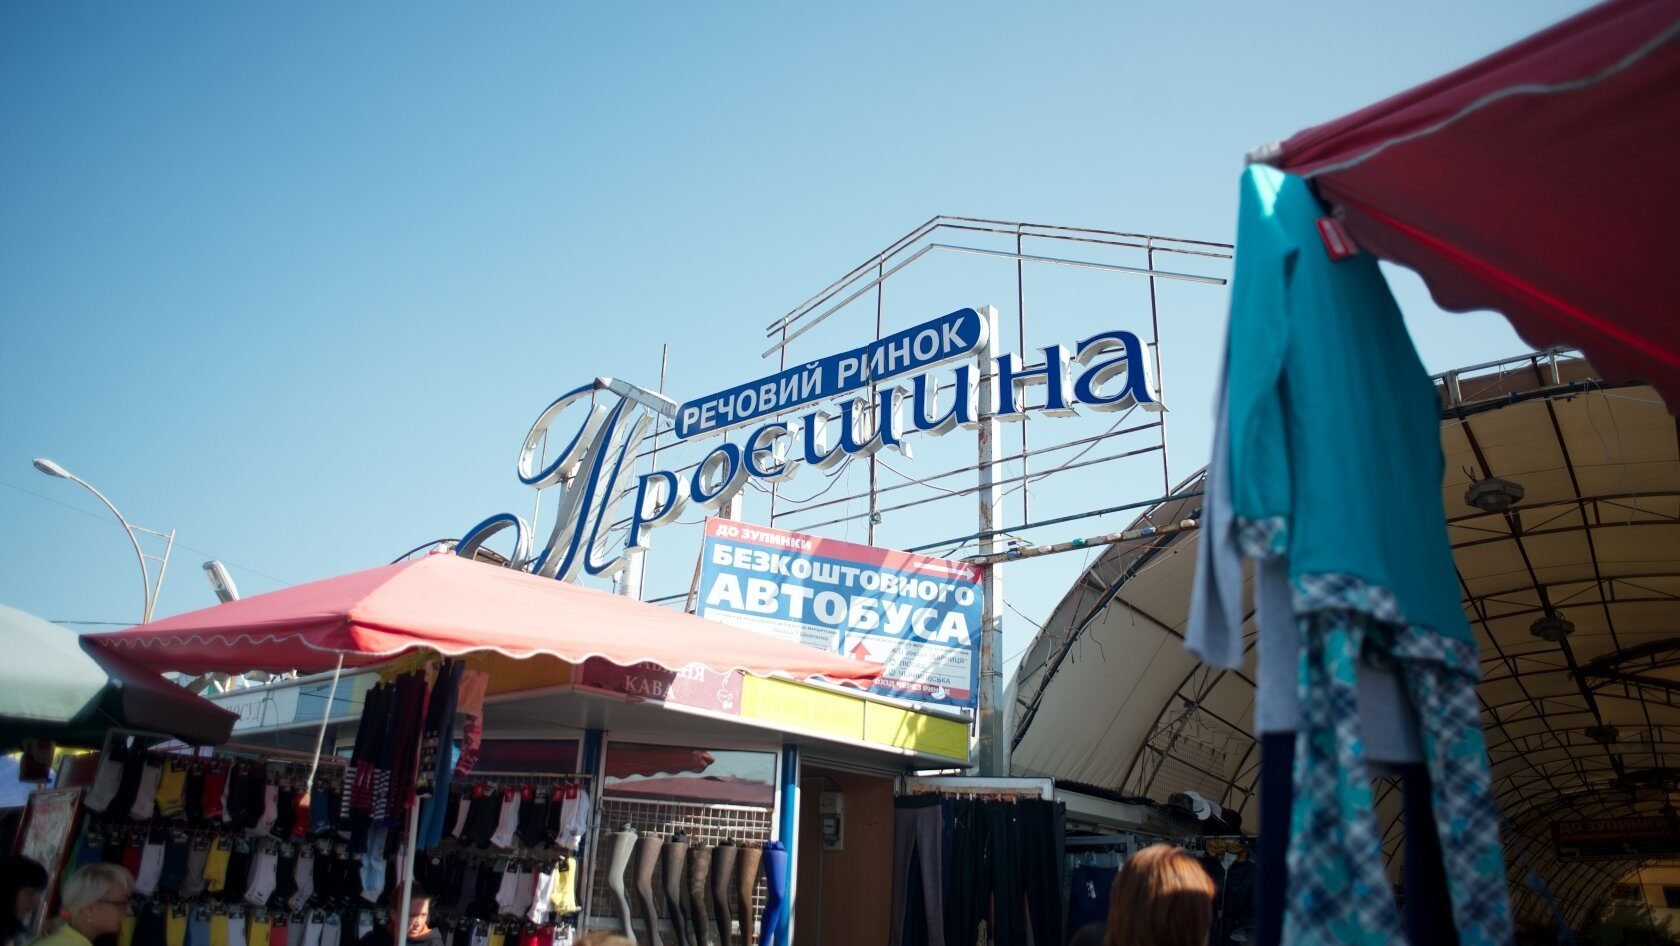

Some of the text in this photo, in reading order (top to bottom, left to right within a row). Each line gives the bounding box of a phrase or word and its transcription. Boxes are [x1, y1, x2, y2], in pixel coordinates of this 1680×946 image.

[681, 316, 969, 435] РЕЧОВИЙ РИНОК
[716, 524, 812, 551] ДО ЗУПИНКИ
[712, 543, 975, 607] БЕЗКОШТОВНОГО
[706, 572, 972, 646] АВТОБУСА
[625, 675, 676, 700] КАВА
[922, 684, 951, 696] РИНК
